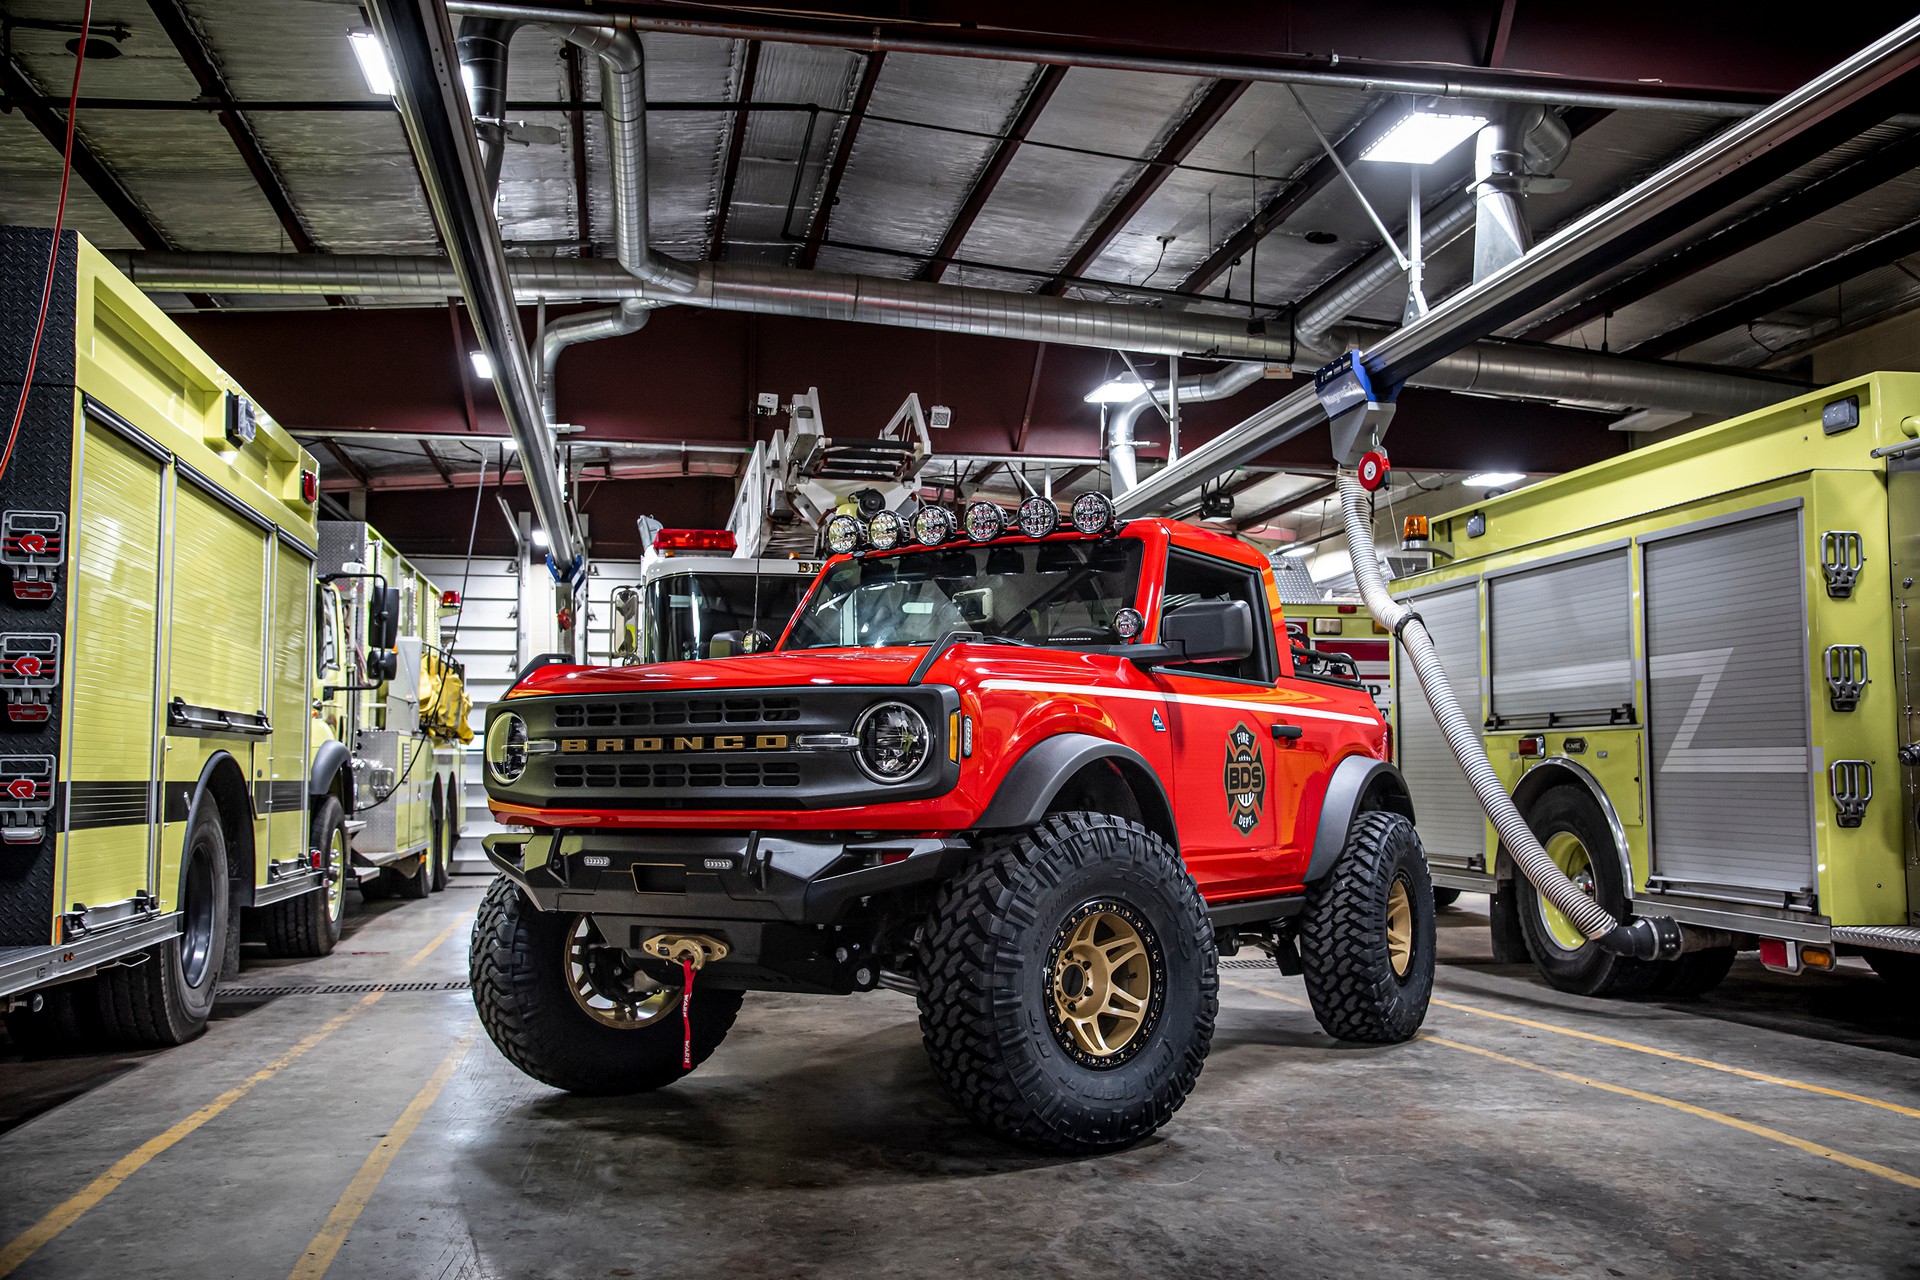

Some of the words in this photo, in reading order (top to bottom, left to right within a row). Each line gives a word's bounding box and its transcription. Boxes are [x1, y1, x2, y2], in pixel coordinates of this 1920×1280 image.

[562, 735, 788, 752] BRONCO
[1237, 731, 1250, 746] FIRE
[1229, 764, 1262, 793] BDS
